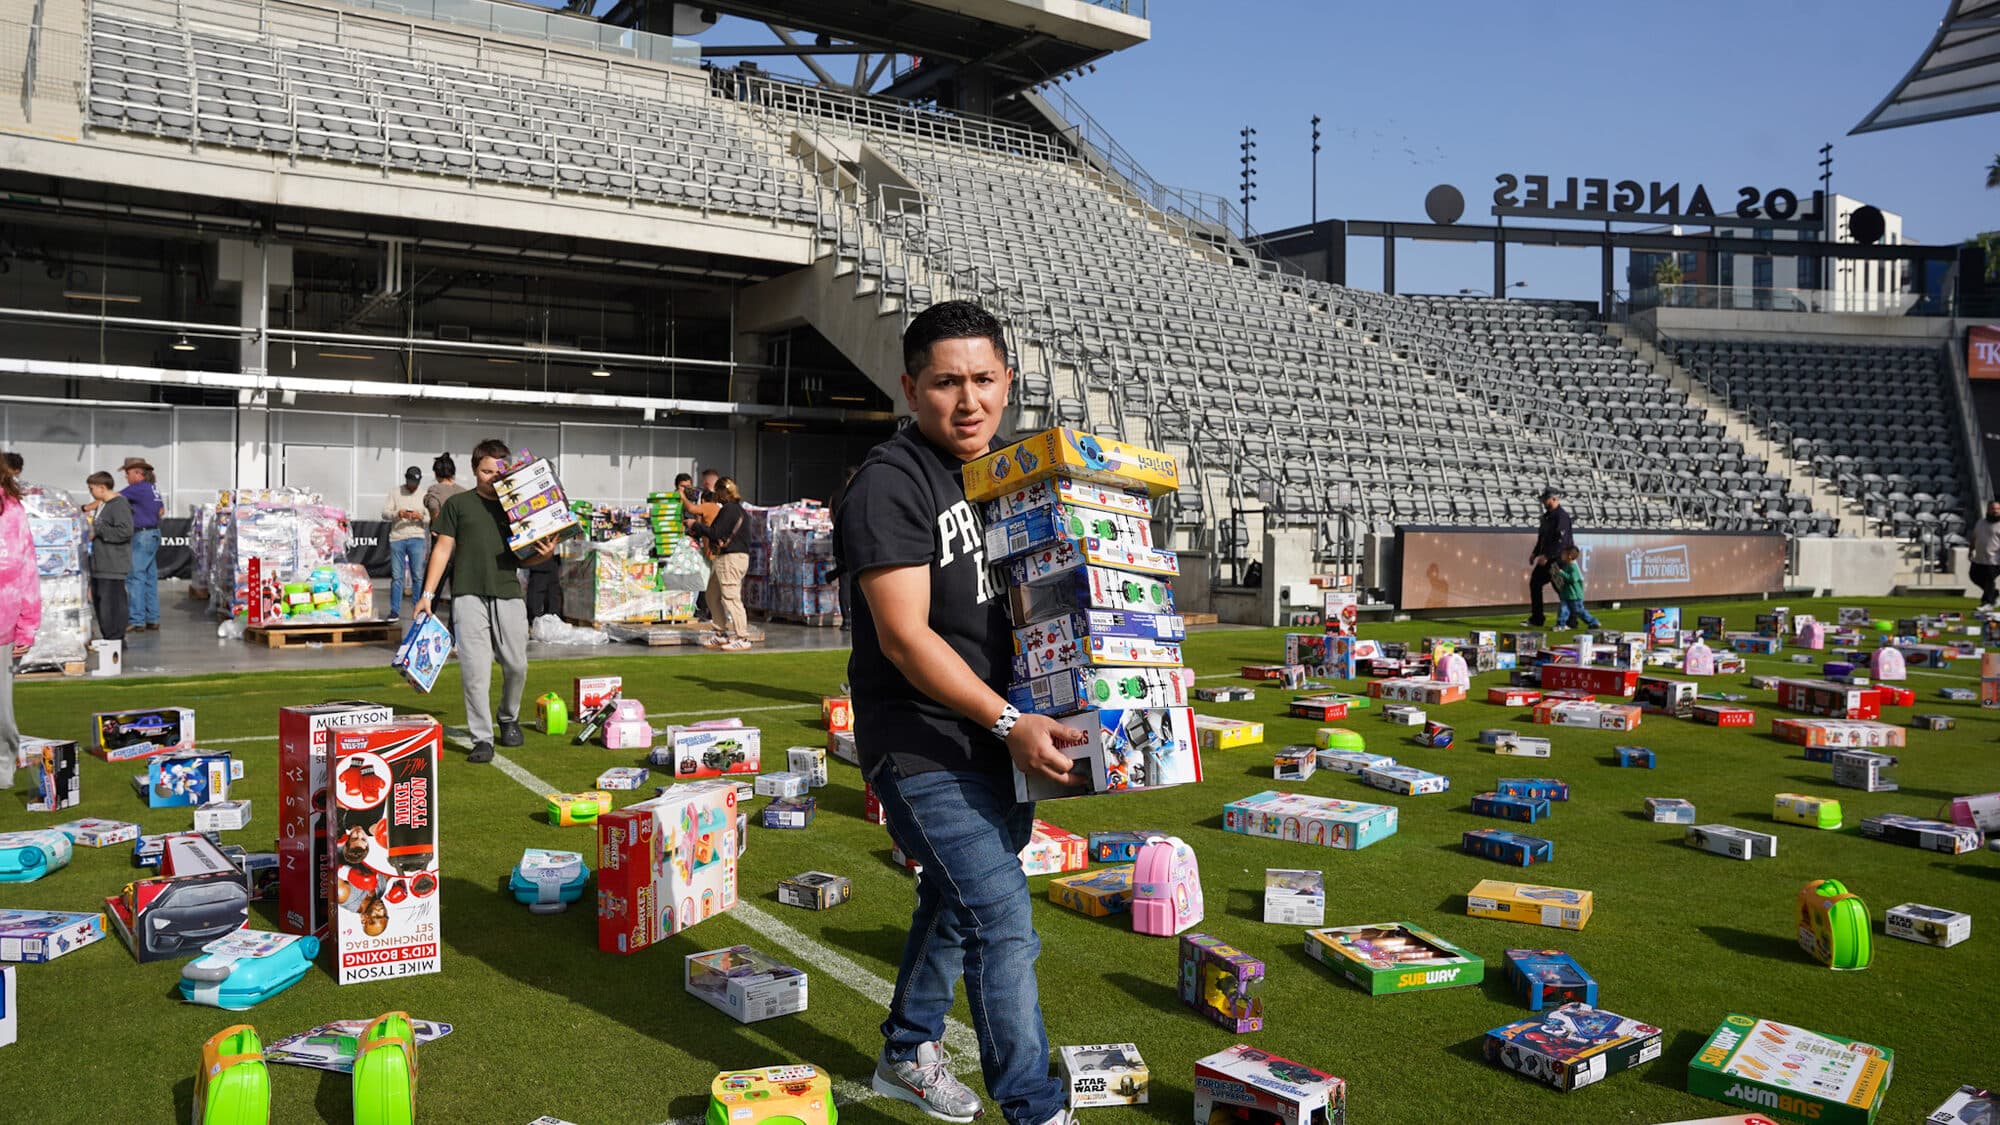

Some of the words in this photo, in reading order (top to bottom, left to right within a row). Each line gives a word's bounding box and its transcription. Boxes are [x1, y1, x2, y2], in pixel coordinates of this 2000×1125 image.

[160, 536, 190, 546] TADI
[937, 499, 984, 568] PR
[1644, 563, 1659, 577] TOY
[1660, 563, 1686, 577] DRIVE
[1552, 677, 1601, 689] TYSON
[1559, 671, 1592, 681] MIKE
[316, 714, 347, 728] MIKE
[349, 711, 389, 723] TYSON
[285, 743, 296, 871] TYSON
[296, 766, 304, 852] MIKE
[395, 782, 410, 826] MIKE
[411, 776, 427, 829] TYSON
[638, 887, 650, 944] MARKET
[416, 923, 433, 933] SET
[346, 941, 369, 951] BAG
[372, 933, 433, 947] PUNCHING
[345, 951, 398, 966] BOXING
[401, 944, 434, 959] KID'S
[347, 967, 396, 981] TYSON
[400, 960, 434, 974] MIKE
[1398, 967, 1461, 988] SUBWAY
[1700, 1026, 1742, 1067] SUBWAY
[1074, 1077, 1107, 1087] STAR
[1074, 1084, 1107, 1093] WARS
[1724, 1084, 1825, 1120] SUBWAY
